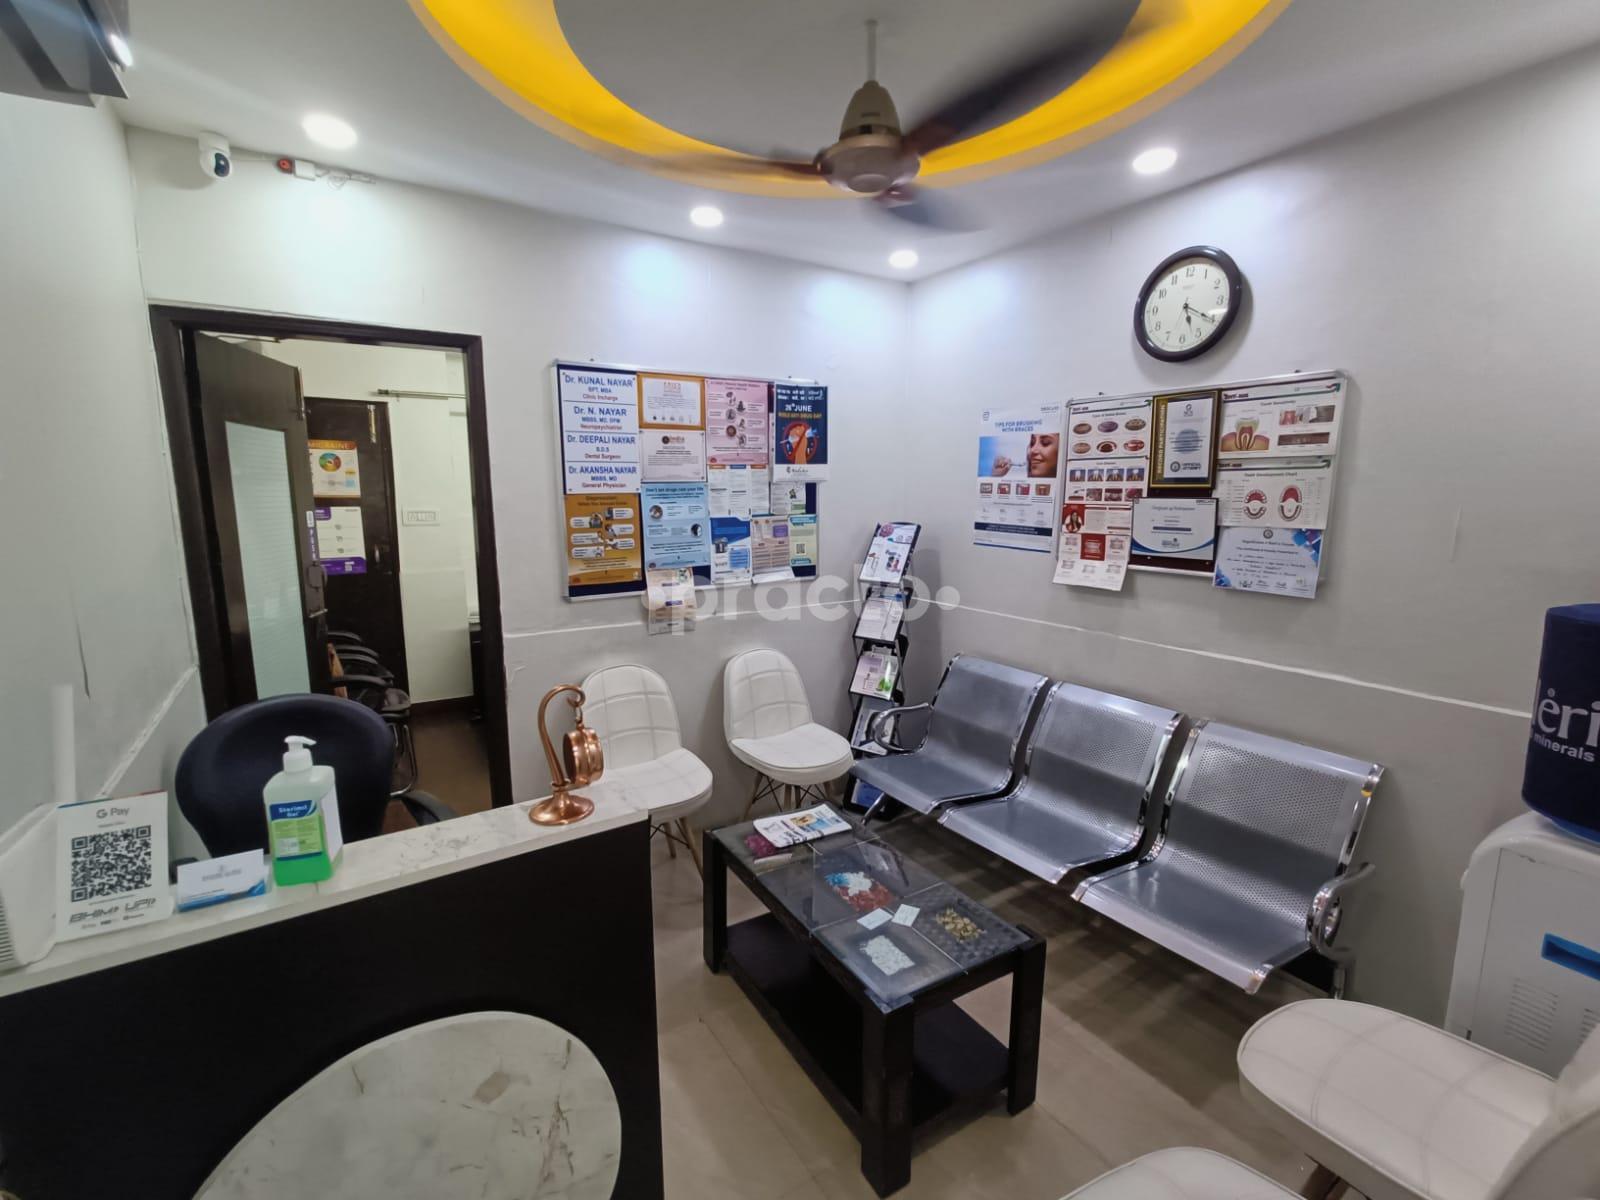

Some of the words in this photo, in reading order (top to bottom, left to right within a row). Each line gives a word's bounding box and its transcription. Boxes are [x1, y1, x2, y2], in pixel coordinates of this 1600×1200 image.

[1186, 266, 1196, 278] 12
[1171, 274, 1178, 286] 11
[1158, 288, 1167, 299] 10
[1216, 295, 1224, 306] 3
[565, 375, 576, 384] Dr.
[578, 376, 605, 386] KUNAL
[608, 378, 633, 387] NAYAR
[574, 406, 586, 414] Dr.
[598, 408, 627, 416] NAYAR
[578, 436, 610, 444] DEEPALI
[568, 466, 578, 474] Dr.
[1534, 732, 1595, 762] minerals
[110, 807, 130, 817] Pay
